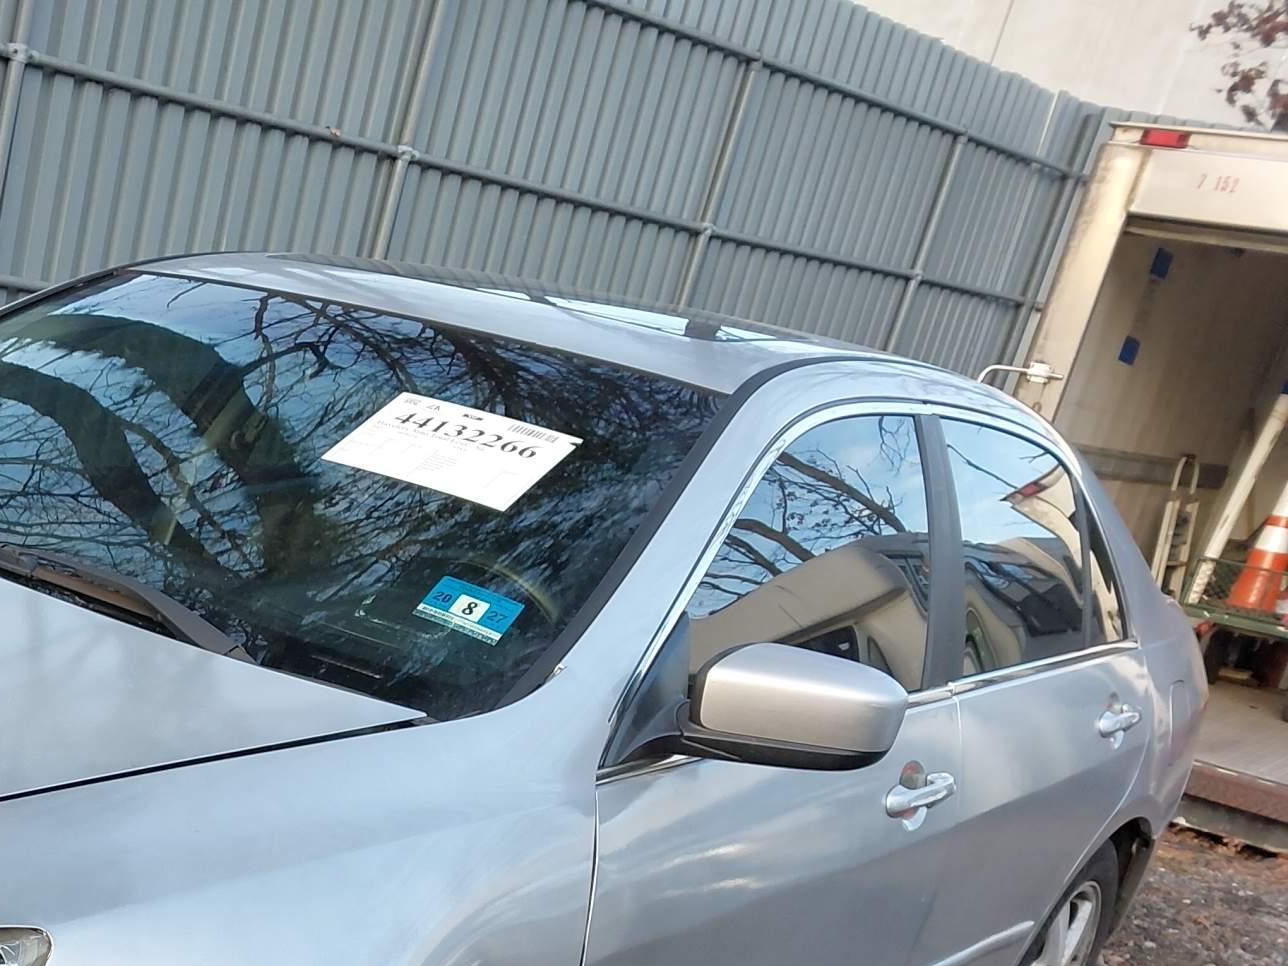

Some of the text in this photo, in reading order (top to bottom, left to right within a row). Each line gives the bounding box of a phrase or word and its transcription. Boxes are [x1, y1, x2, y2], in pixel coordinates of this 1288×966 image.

[1213, 175, 1240, 193] 152
[394, 412, 541, 459] 44132266
[432, 591, 508, 624] 20 8 27
